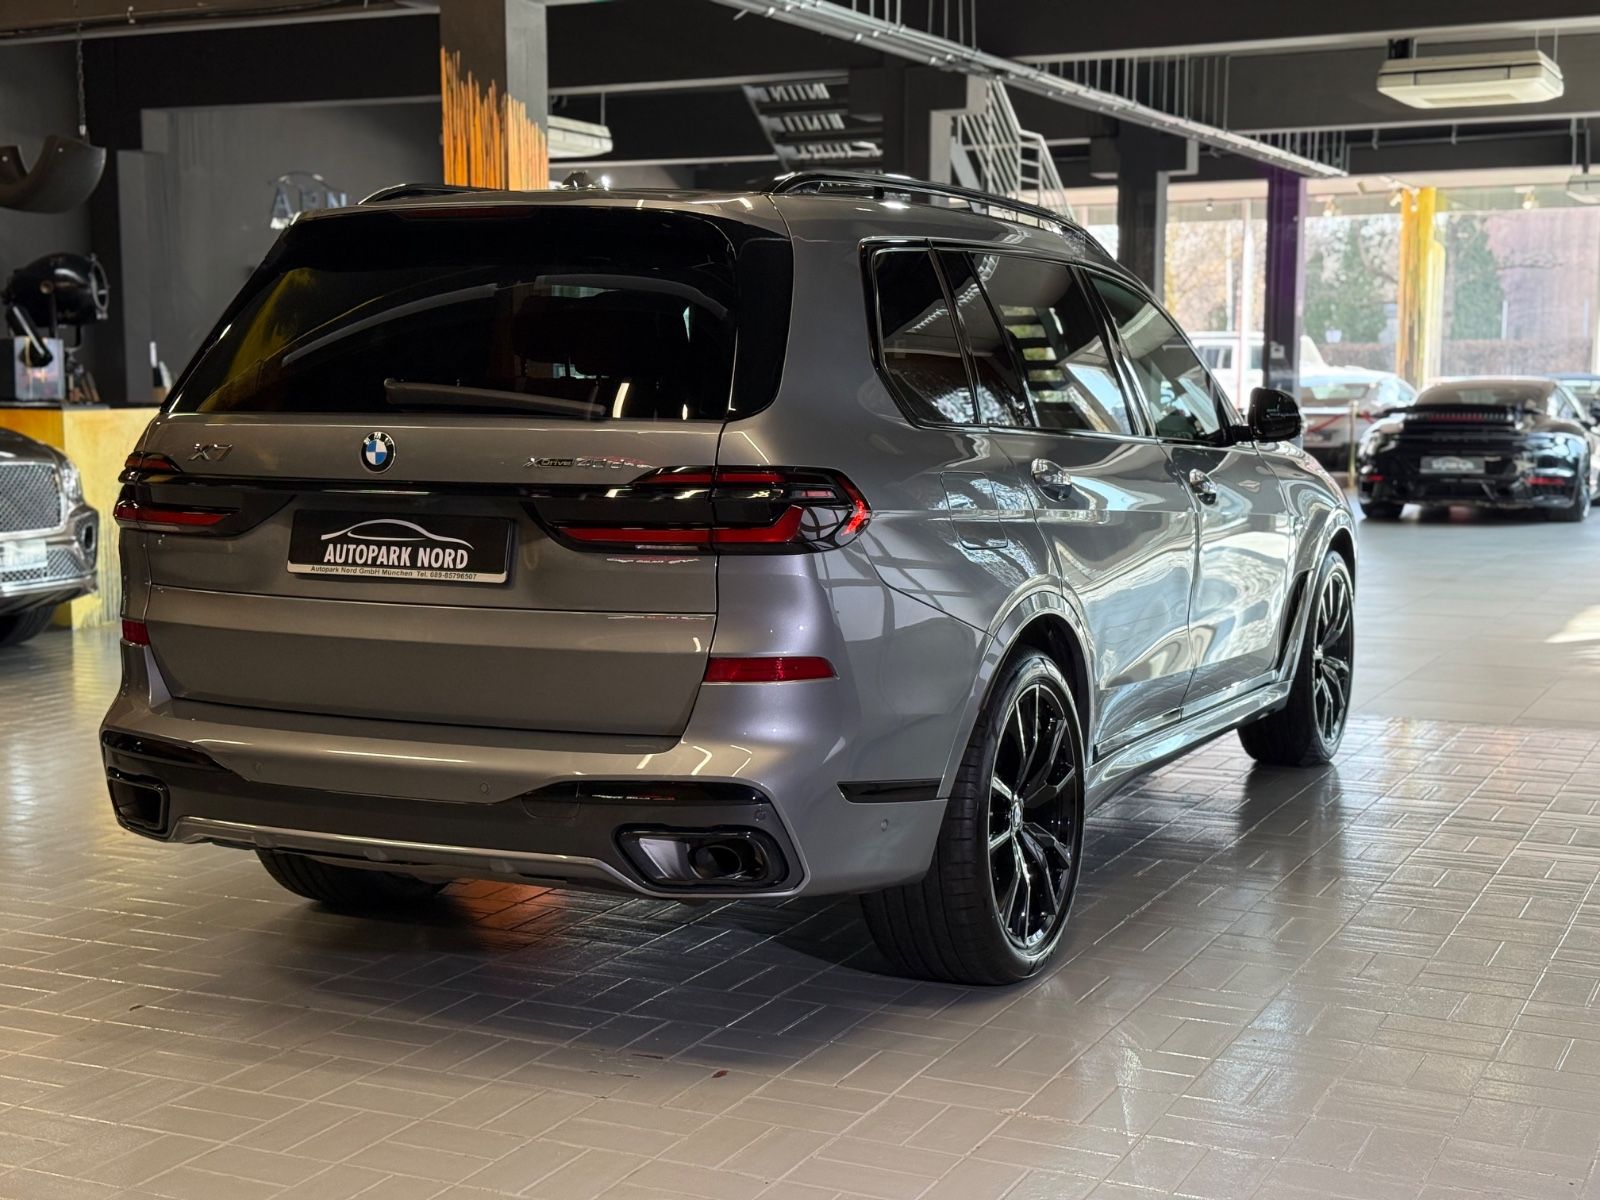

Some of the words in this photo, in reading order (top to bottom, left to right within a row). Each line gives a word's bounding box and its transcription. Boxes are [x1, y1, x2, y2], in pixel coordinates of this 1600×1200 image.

[189, 443, 232, 461] X7
[323, 543, 412, 567] AUTOPARK
[417, 547, 468, 569] NORD
[310, 565, 340, 573] Autopark
